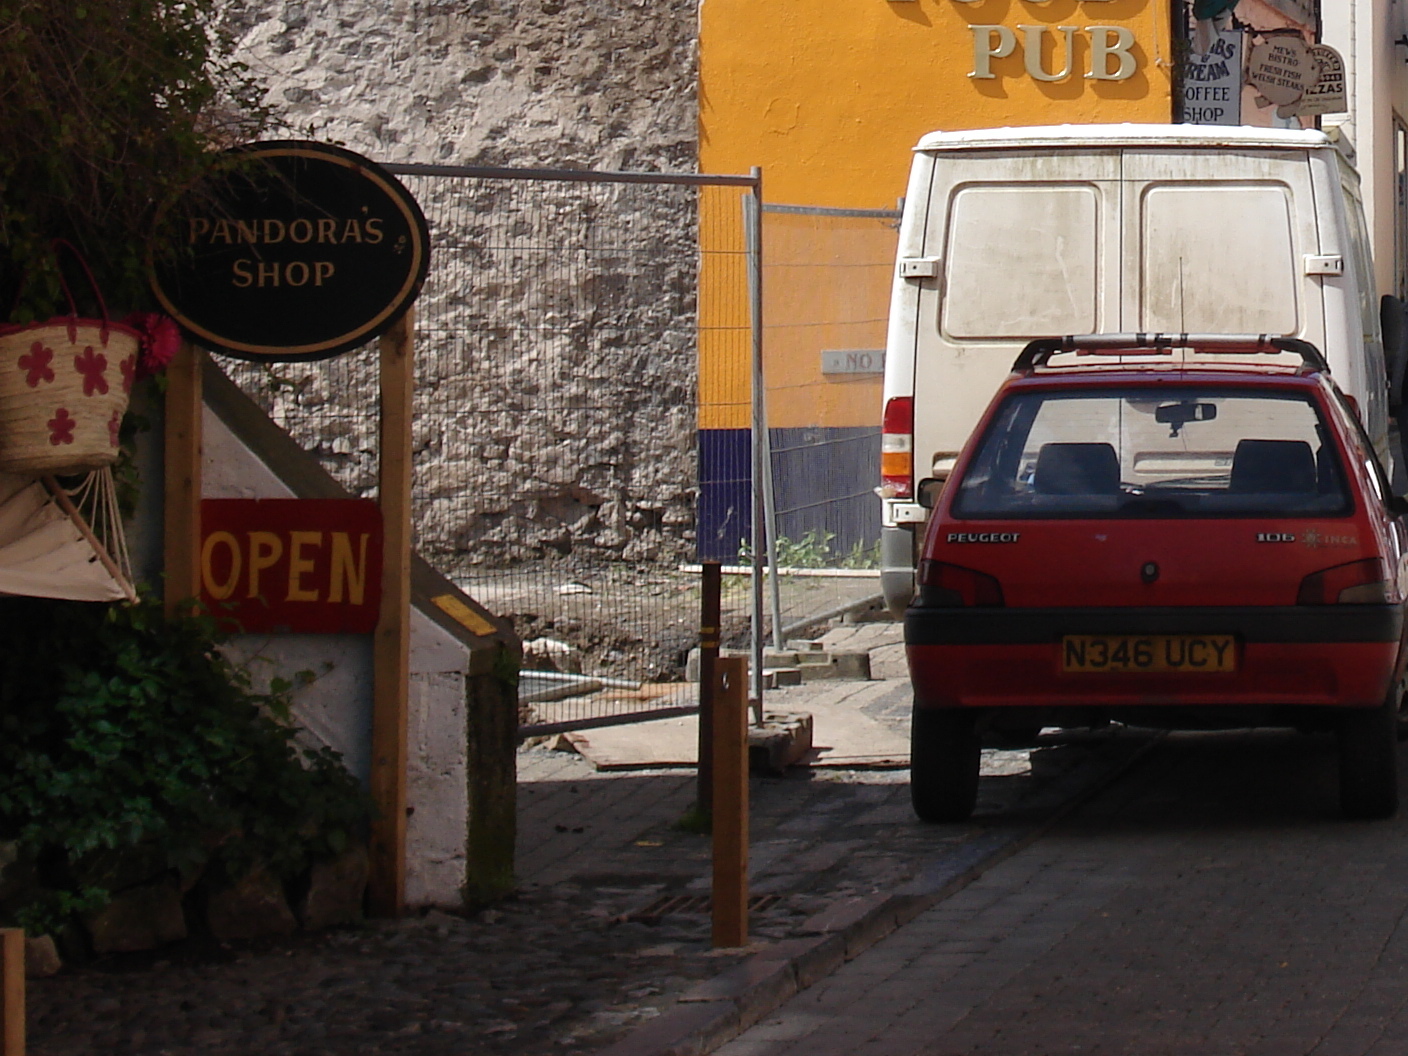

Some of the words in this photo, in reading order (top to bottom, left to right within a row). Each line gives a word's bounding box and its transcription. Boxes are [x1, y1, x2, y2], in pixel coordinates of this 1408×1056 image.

[966, 24, 1137, 81] PUB
[1268, 53, 1298, 67] BISTRO
[1284, 70, 1302, 80] FISH
[1185, 87, 1230, 101] OFFEE
[1184, 108, 1224, 122] SHOP
[189, 206, 384, 244] PANDORA'S
[232, 259, 335, 287] SHOP
[845, 353, 872, 369] NO
[947, 533, 1020, 542] PEUGEOT
[1257, 533, 1295, 542] 106
[201, 530, 370, 605] OPEN
[1065, 639, 1153, 668] N346
[1165, 639, 1229, 667] UCY
